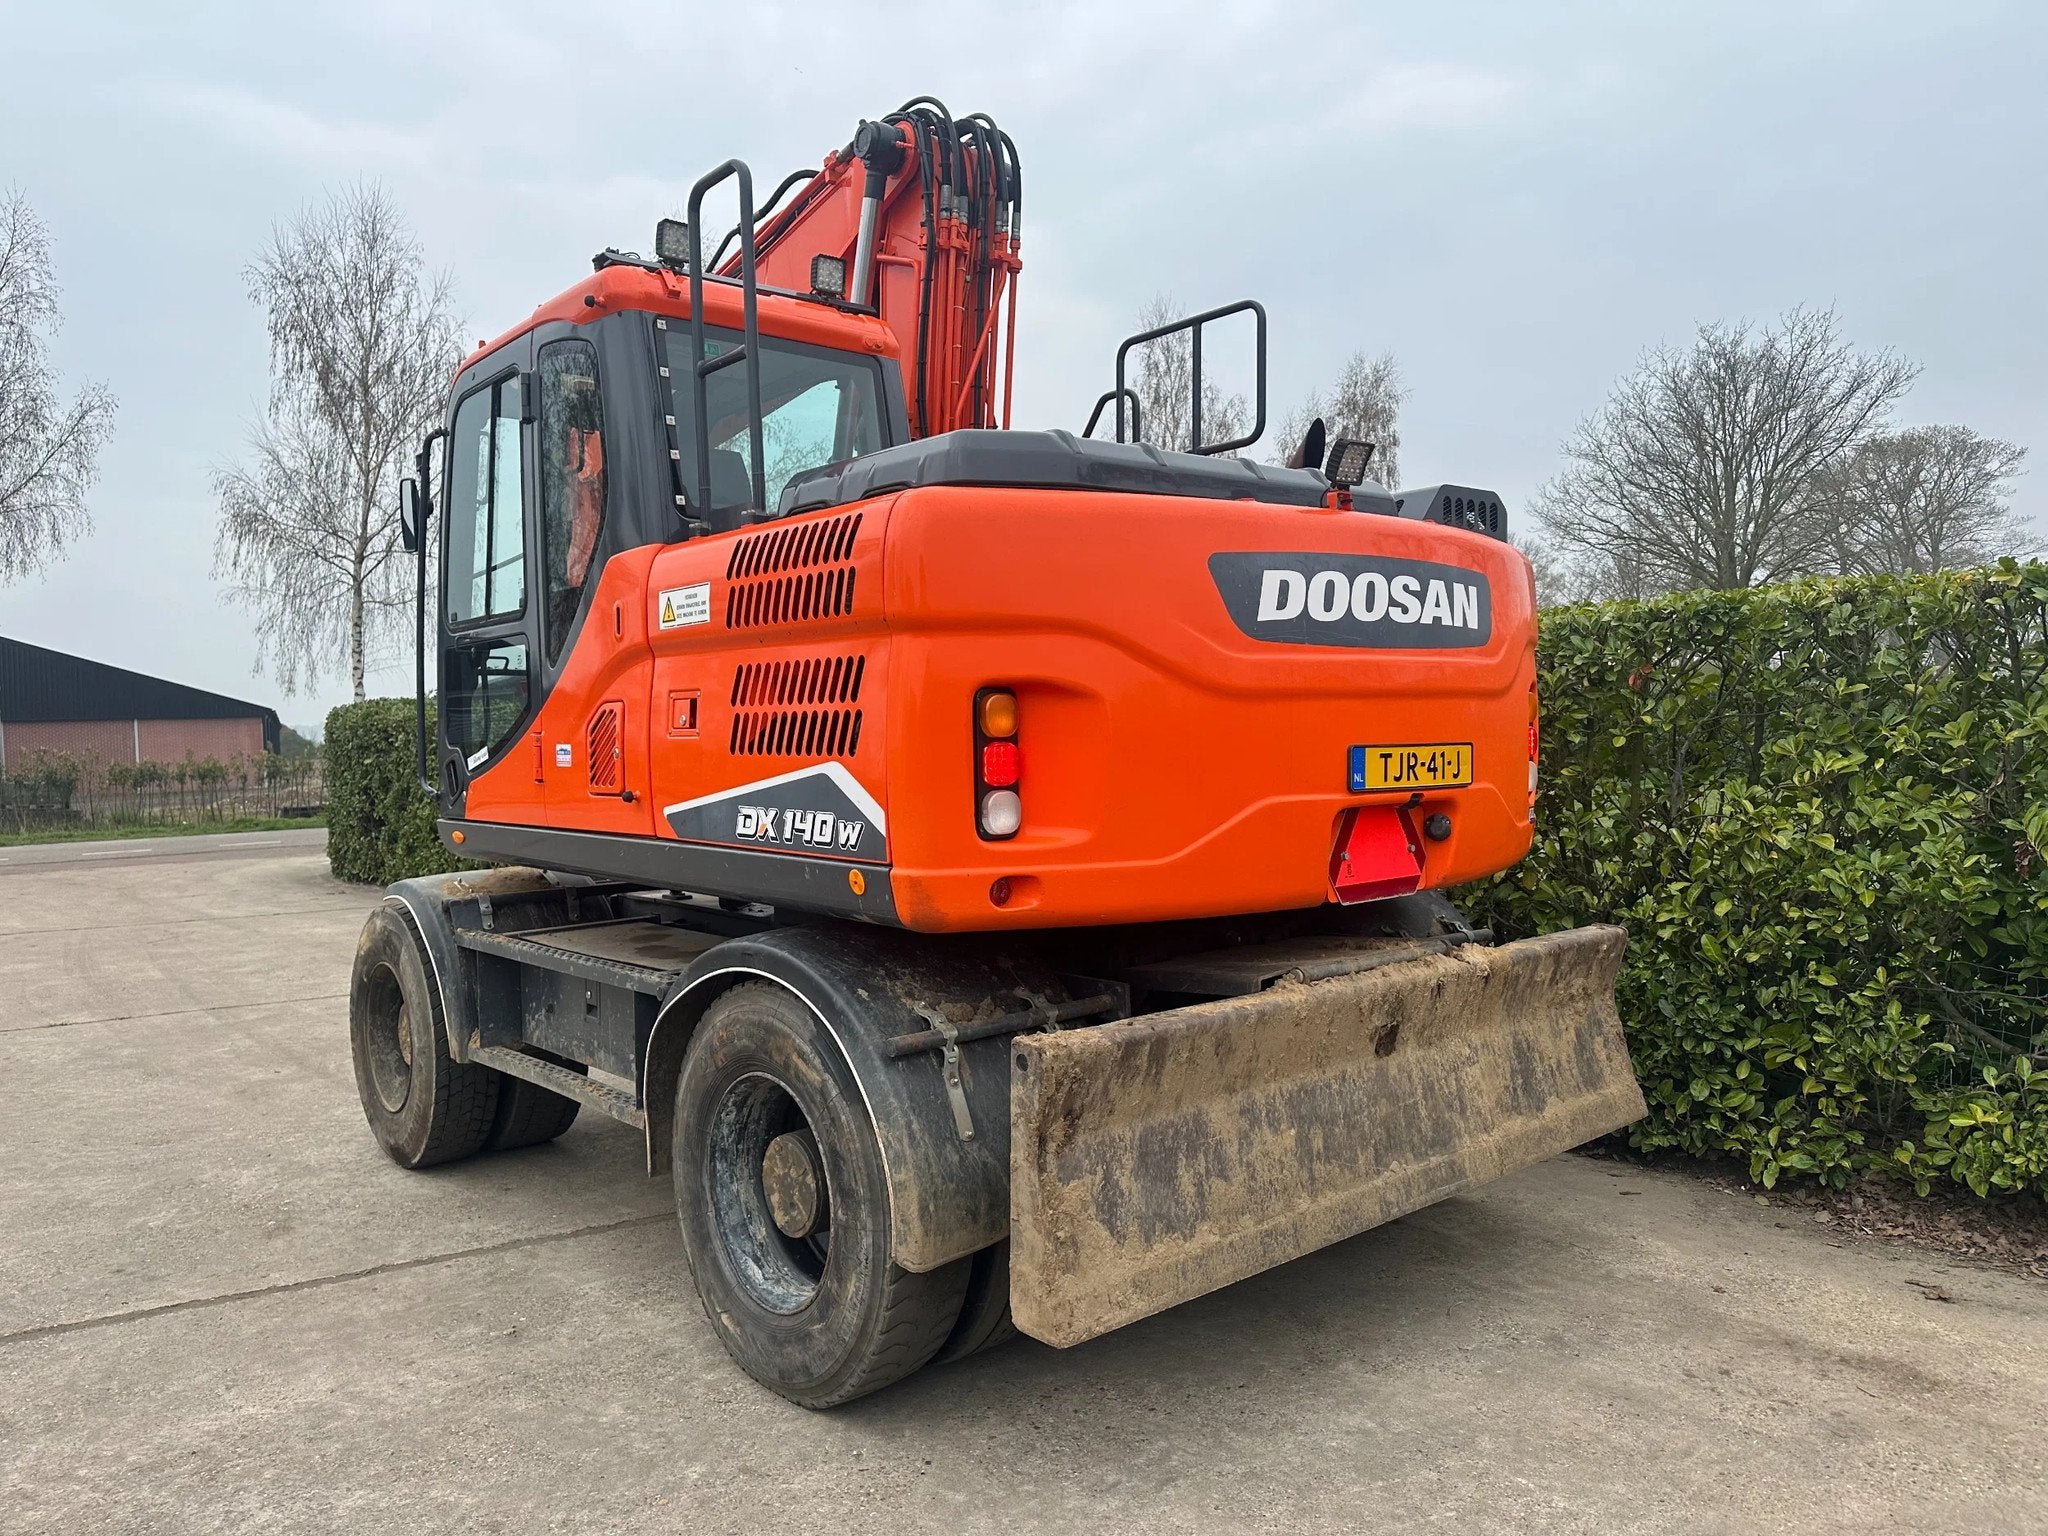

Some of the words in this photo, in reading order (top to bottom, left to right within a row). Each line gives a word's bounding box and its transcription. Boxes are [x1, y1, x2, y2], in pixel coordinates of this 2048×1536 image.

[1257, 569, 1479, 630] DOOSAN
[1353, 773, 1364, 783] NL
[1379, 750, 1461, 783] TJR-41-J
[736, 805, 780, 843] DX
